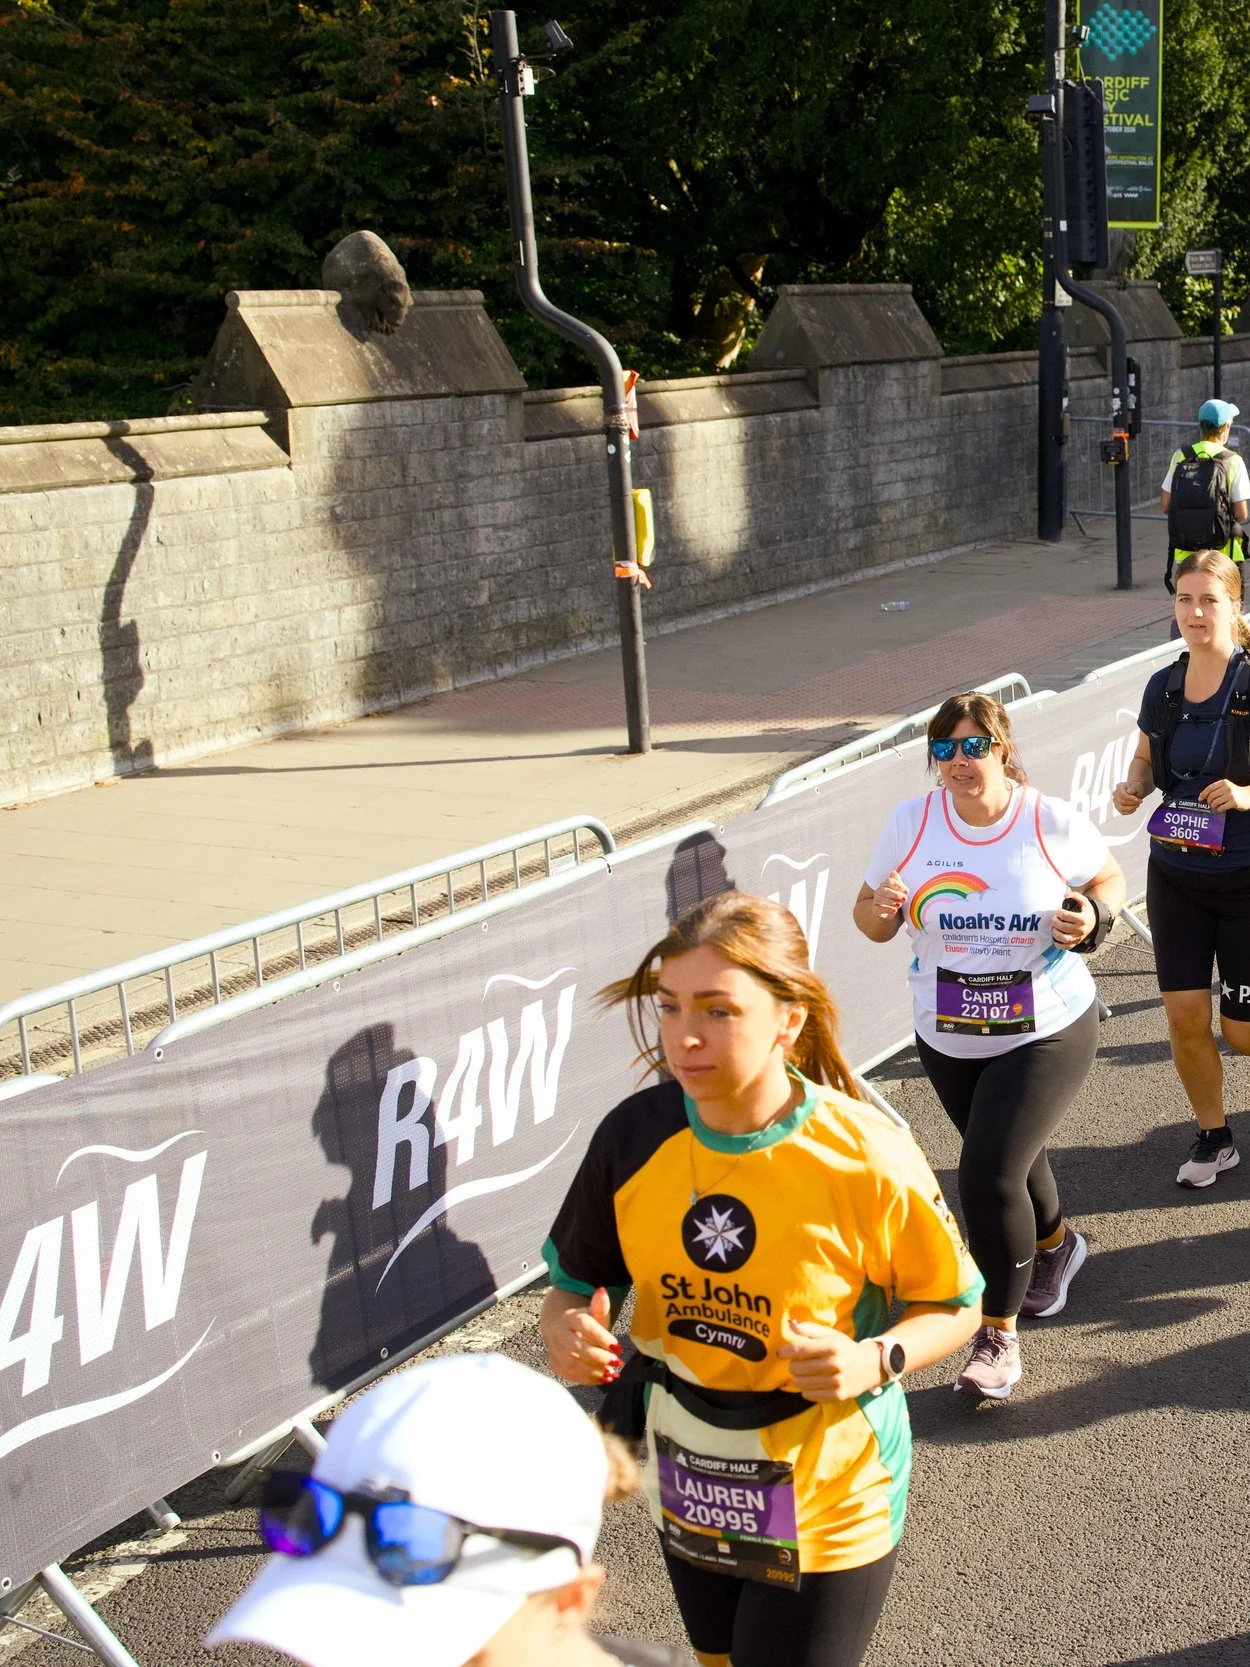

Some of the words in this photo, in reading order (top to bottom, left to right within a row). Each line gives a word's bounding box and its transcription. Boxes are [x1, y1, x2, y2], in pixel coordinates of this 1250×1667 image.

[1105, 89, 1130, 101] SIC
[1104, 113, 1154, 126] STIVAL
[1164, 812, 1210, 829] SOPHIE
[1170, 826, 1200, 841] 3605
[927, 860, 964, 868] AGILIS
[940, 913, 1005, 931] Noah's
[1008, 914, 1042, 932] Ark
[942, 933, 979, 943] Children's
[980, 935, 1010, 945] Hospital
[945, 944, 969, 953] Elusen
[991, 947, 1011, 956] Plant
[968, 975, 996, 983] CARDIFF
[962, 988, 1008, 1005] CARRI
[961, 1003, 1010, 1019] 22107
[372, 984, 577, 1210] R4W
[661, 1273, 695, 1300] St
[701, 1278, 771, 1317] John
[666, 1302, 770, 1338] Ambulance
[695, 1323, 746, 1350] Cymru
[689, 1454, 727, 1472] CARDIFF
[729, 1463, 759, 1474] HALF
[674, 1471, 765, 1511] LAUREN
[683, 1500, 758, 1533] 20995
[766, 1567, 796, 1583] 20995
